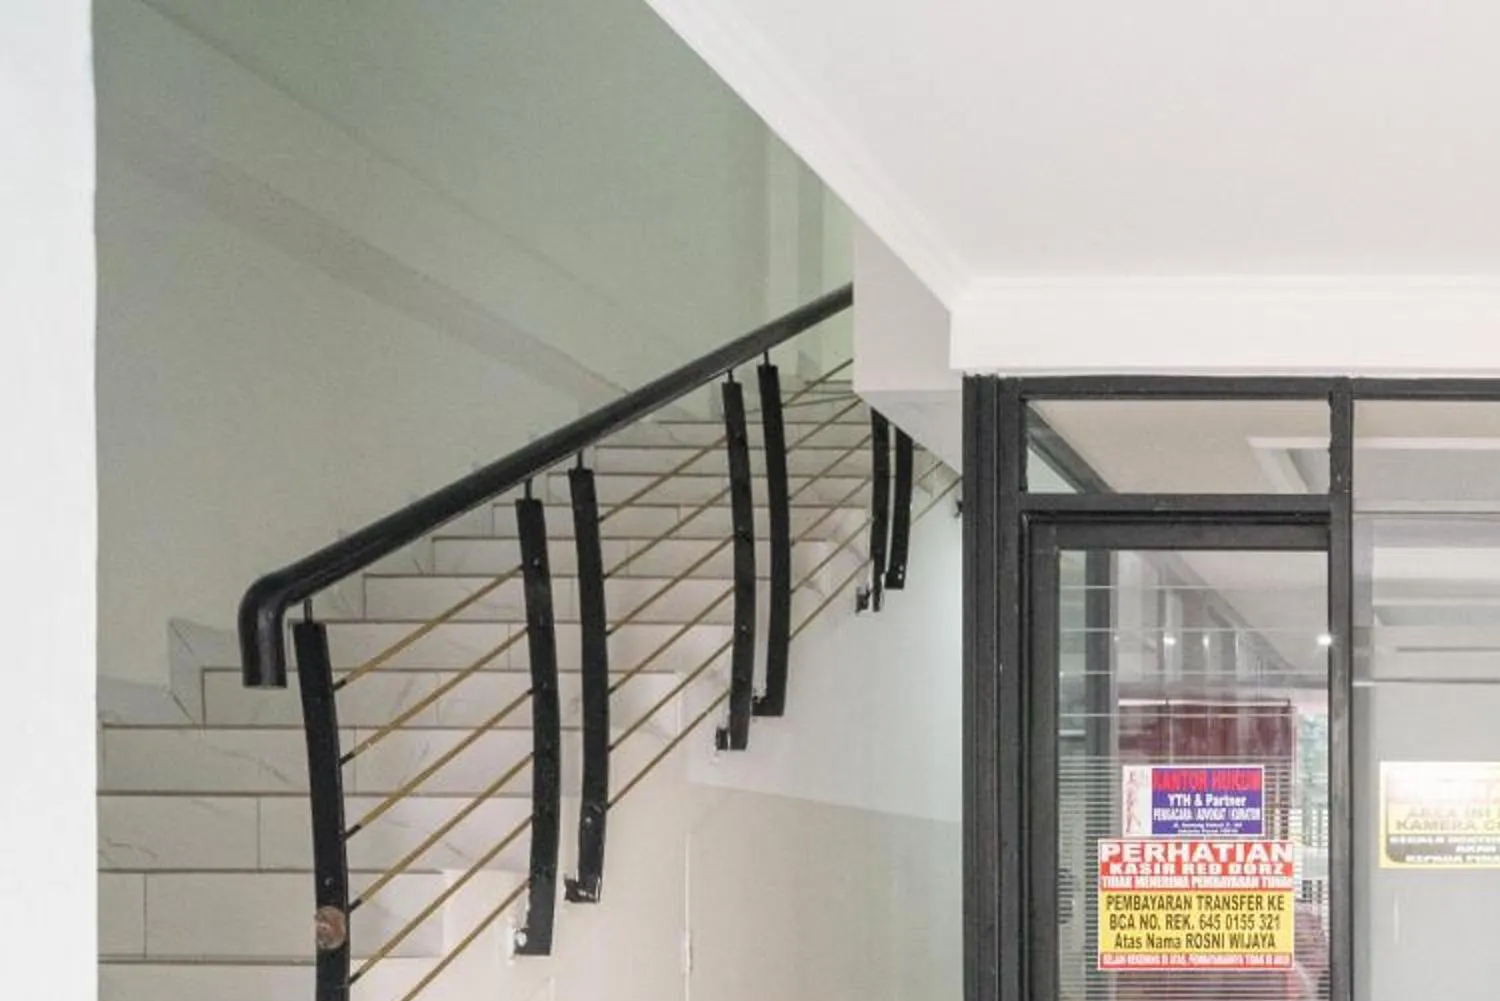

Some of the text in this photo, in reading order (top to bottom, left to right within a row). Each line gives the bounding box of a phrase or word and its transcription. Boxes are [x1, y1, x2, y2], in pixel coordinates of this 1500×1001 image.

[1168, 793, 1247, 807] YTH & Partner
[1396, 820, 1475, 831] KAMERA
[1101, 842, 1292, 862] PERHATIAN
[1110, 863, 1175, 875] KASIR
[1106, 895, 1285, 911] PEMBAYARAN TRANSFER KE
[1109, 914, 1281, 931] BCA NO. REK. 645 0155 321
[1114, 933, 1276, 949] Atas Nama ROSNI WIJAYA
